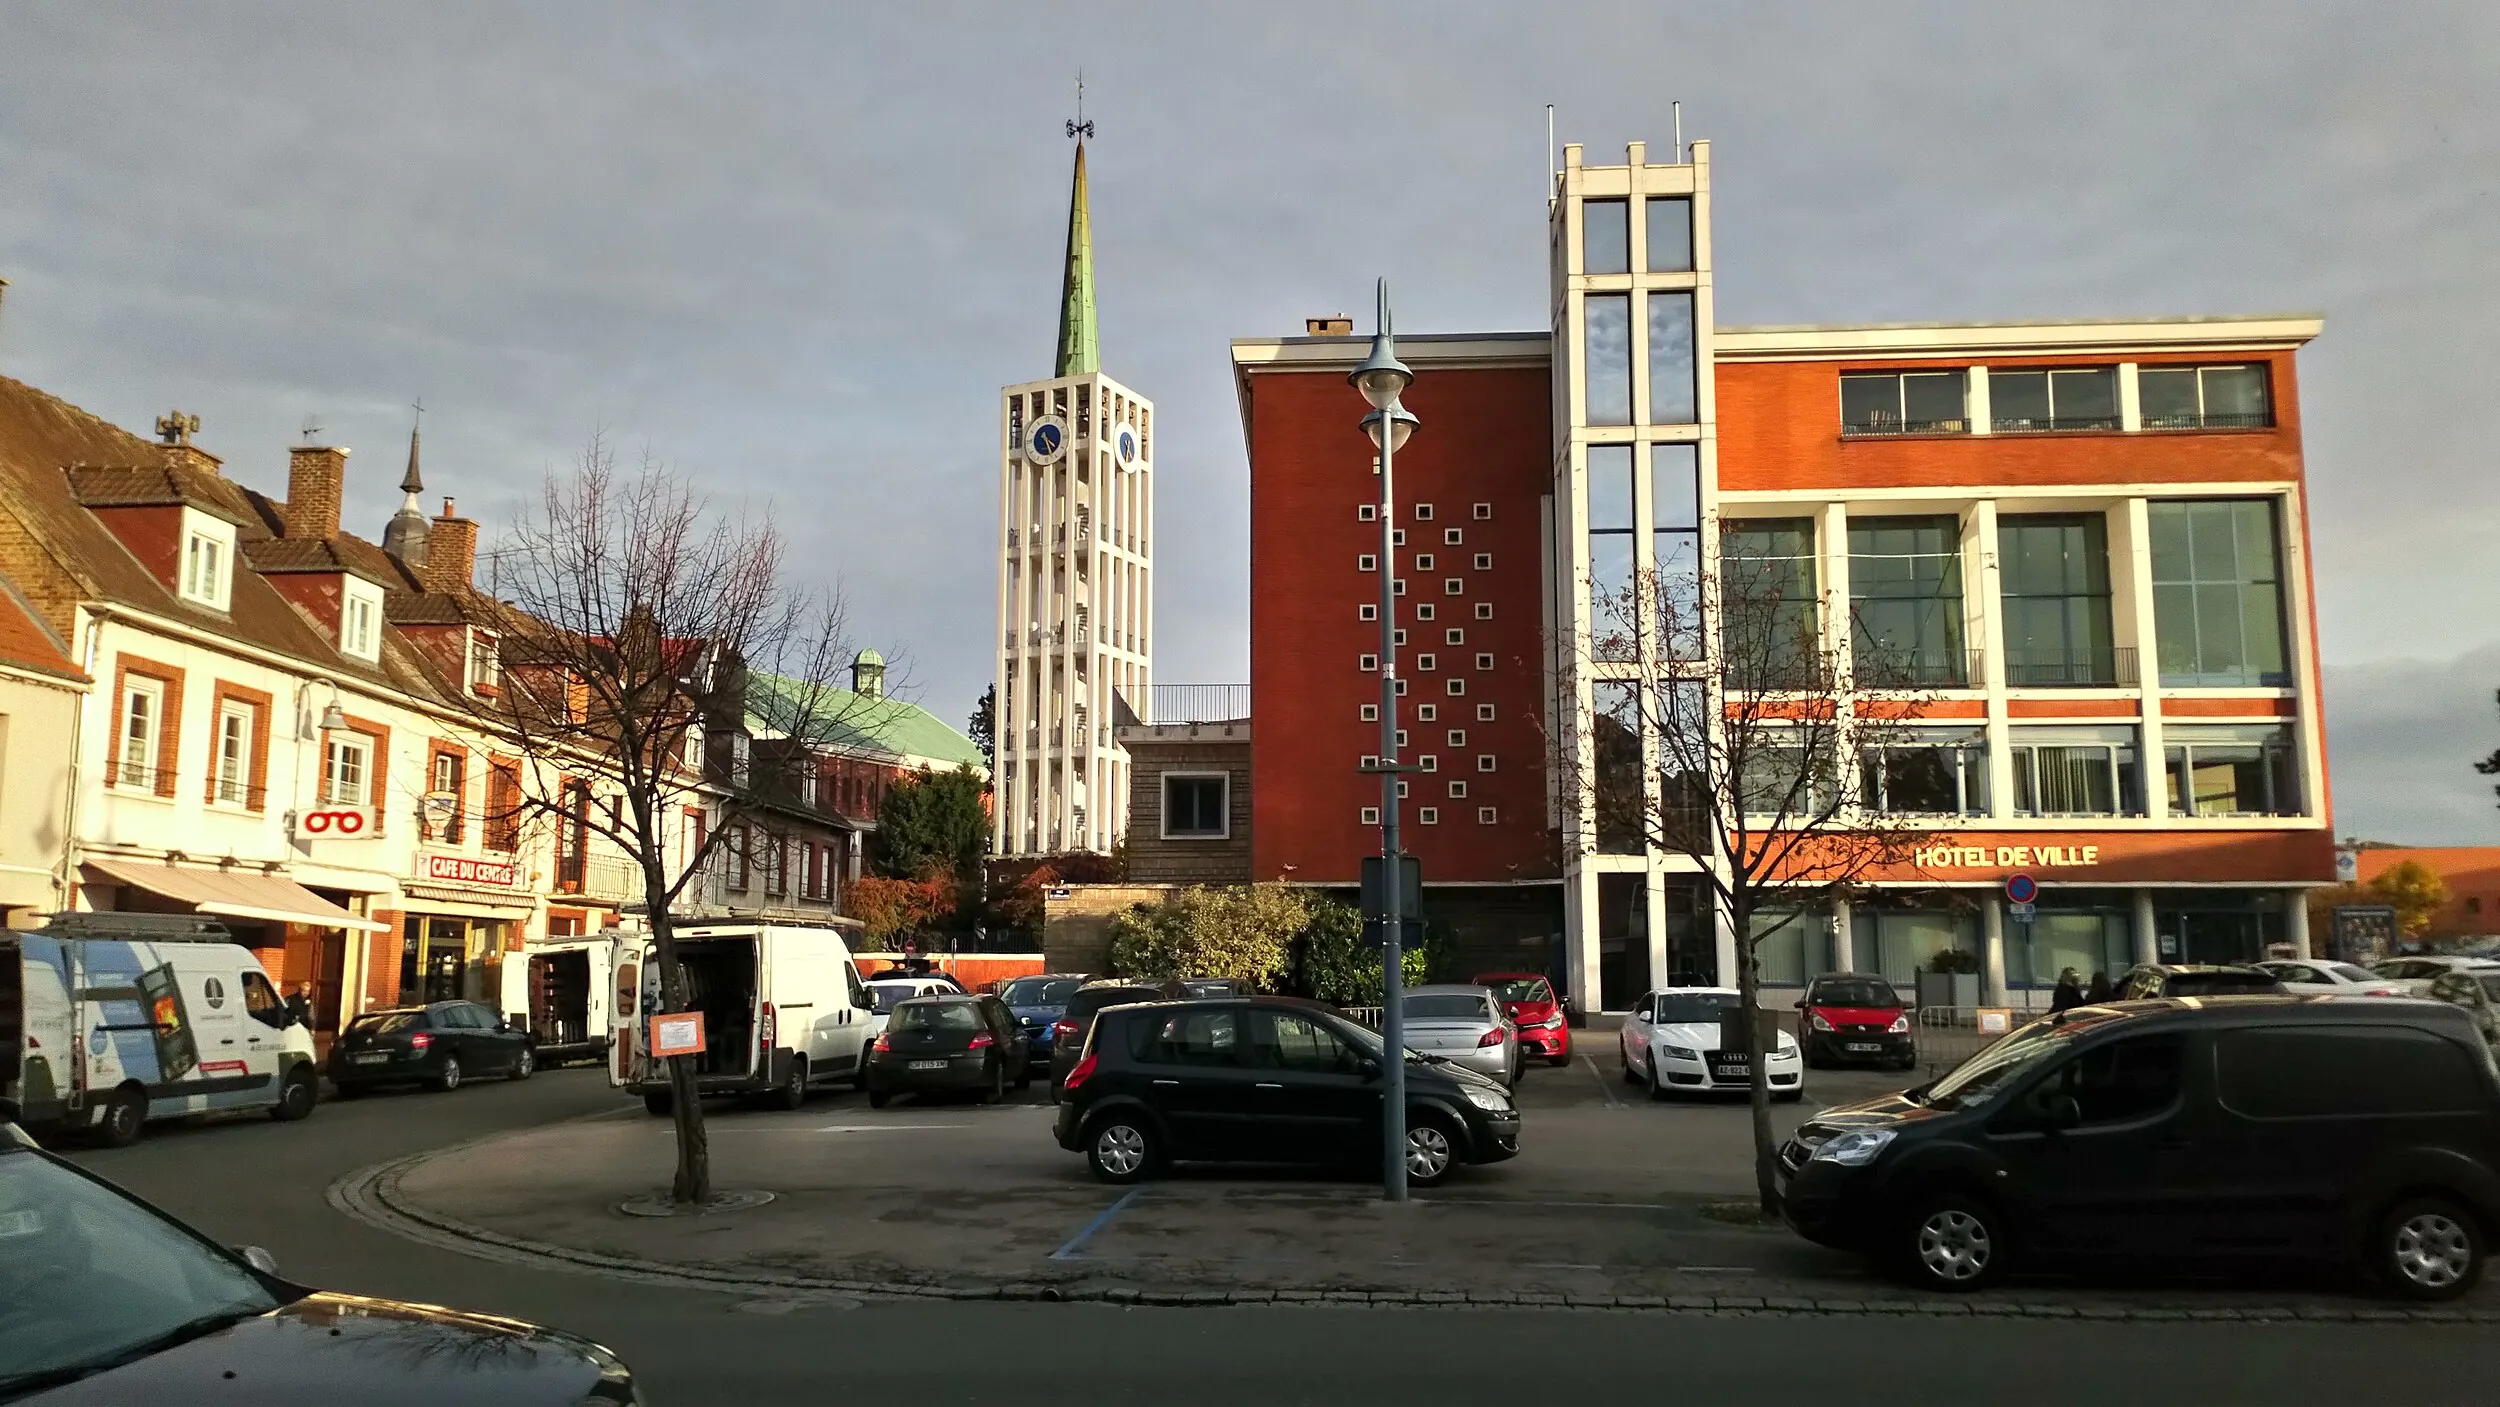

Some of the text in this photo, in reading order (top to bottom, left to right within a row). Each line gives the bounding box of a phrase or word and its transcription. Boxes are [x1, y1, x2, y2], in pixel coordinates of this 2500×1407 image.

[1915, 841, 2098, 867] HÔTEL DE VILLE
[431, 858, 512, 884] CAFE DU CENTRE
